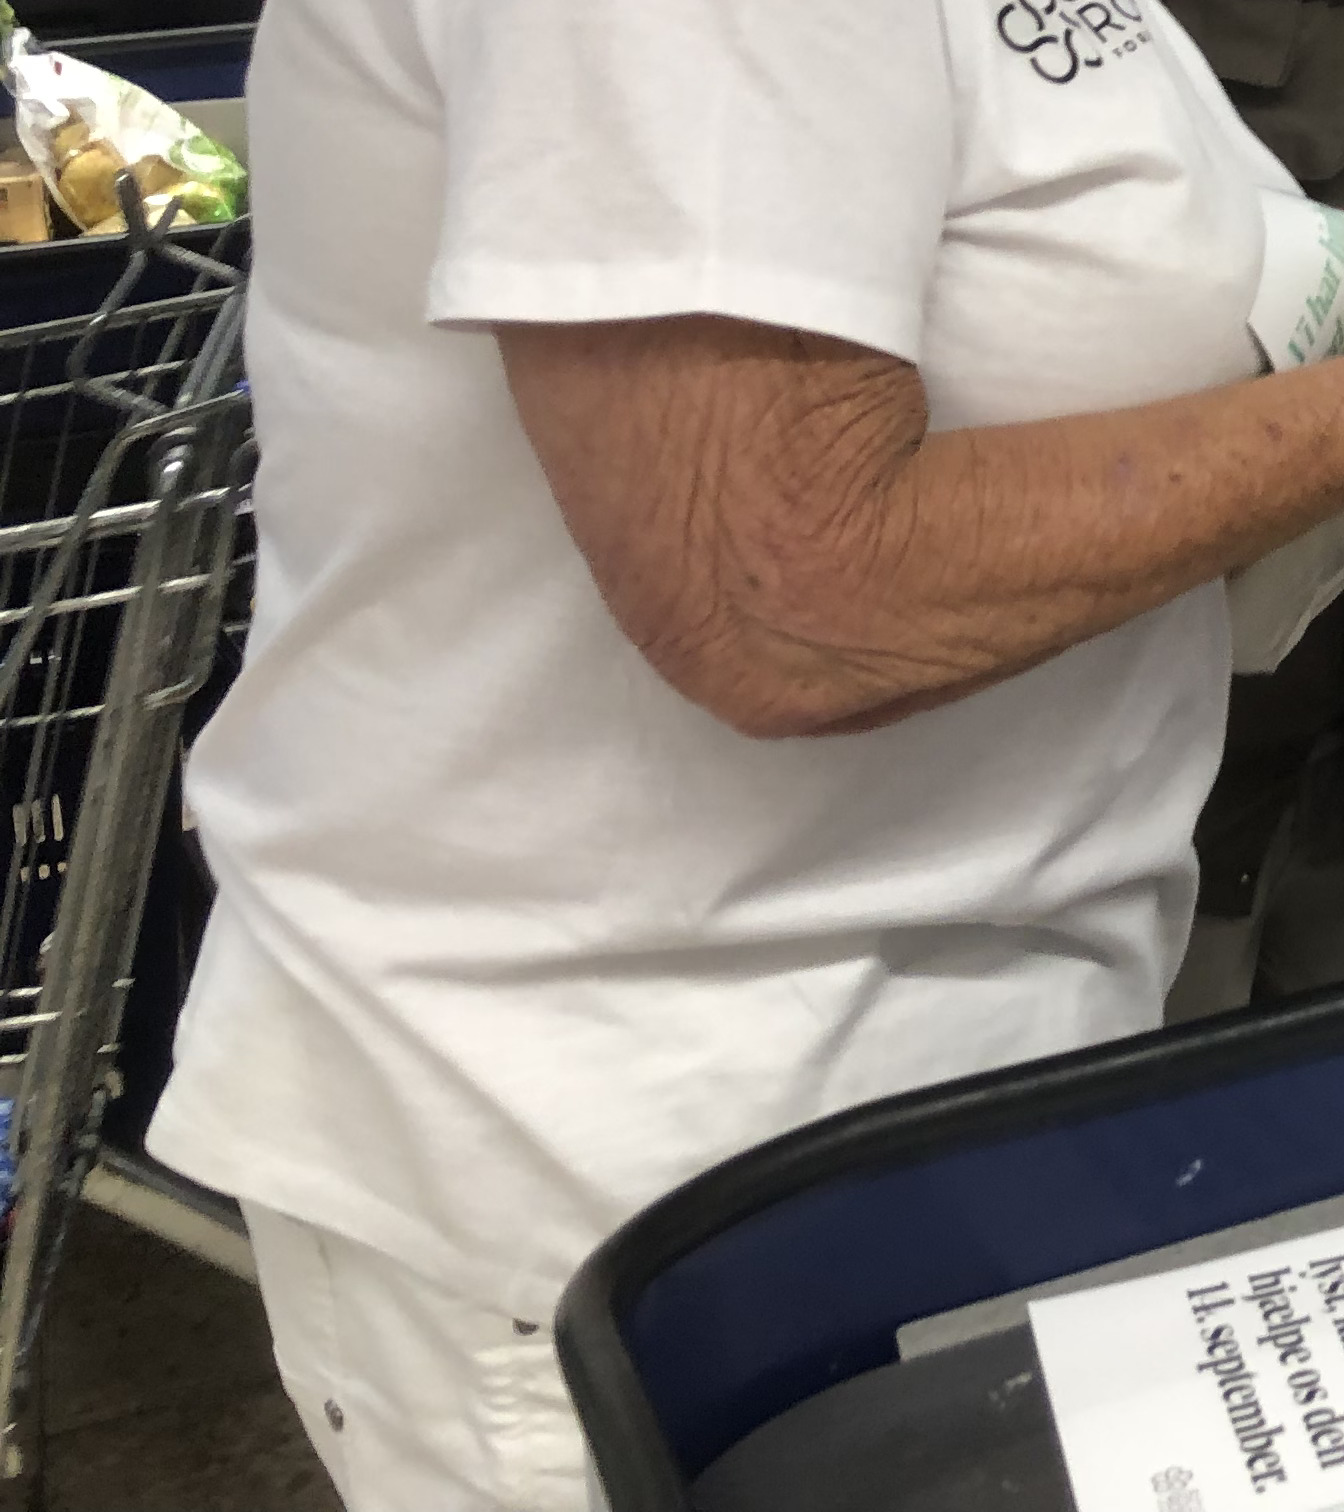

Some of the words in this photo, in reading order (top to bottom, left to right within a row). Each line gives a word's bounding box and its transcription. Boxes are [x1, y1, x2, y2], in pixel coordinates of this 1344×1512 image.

[1186, 1280, 1236, 1325] 14.
[1241, 1266, 1312, 1367] hjælpe
[1286, 1367, 1329, 1406] os
[1195, 1323, 1288, 1495] september.
